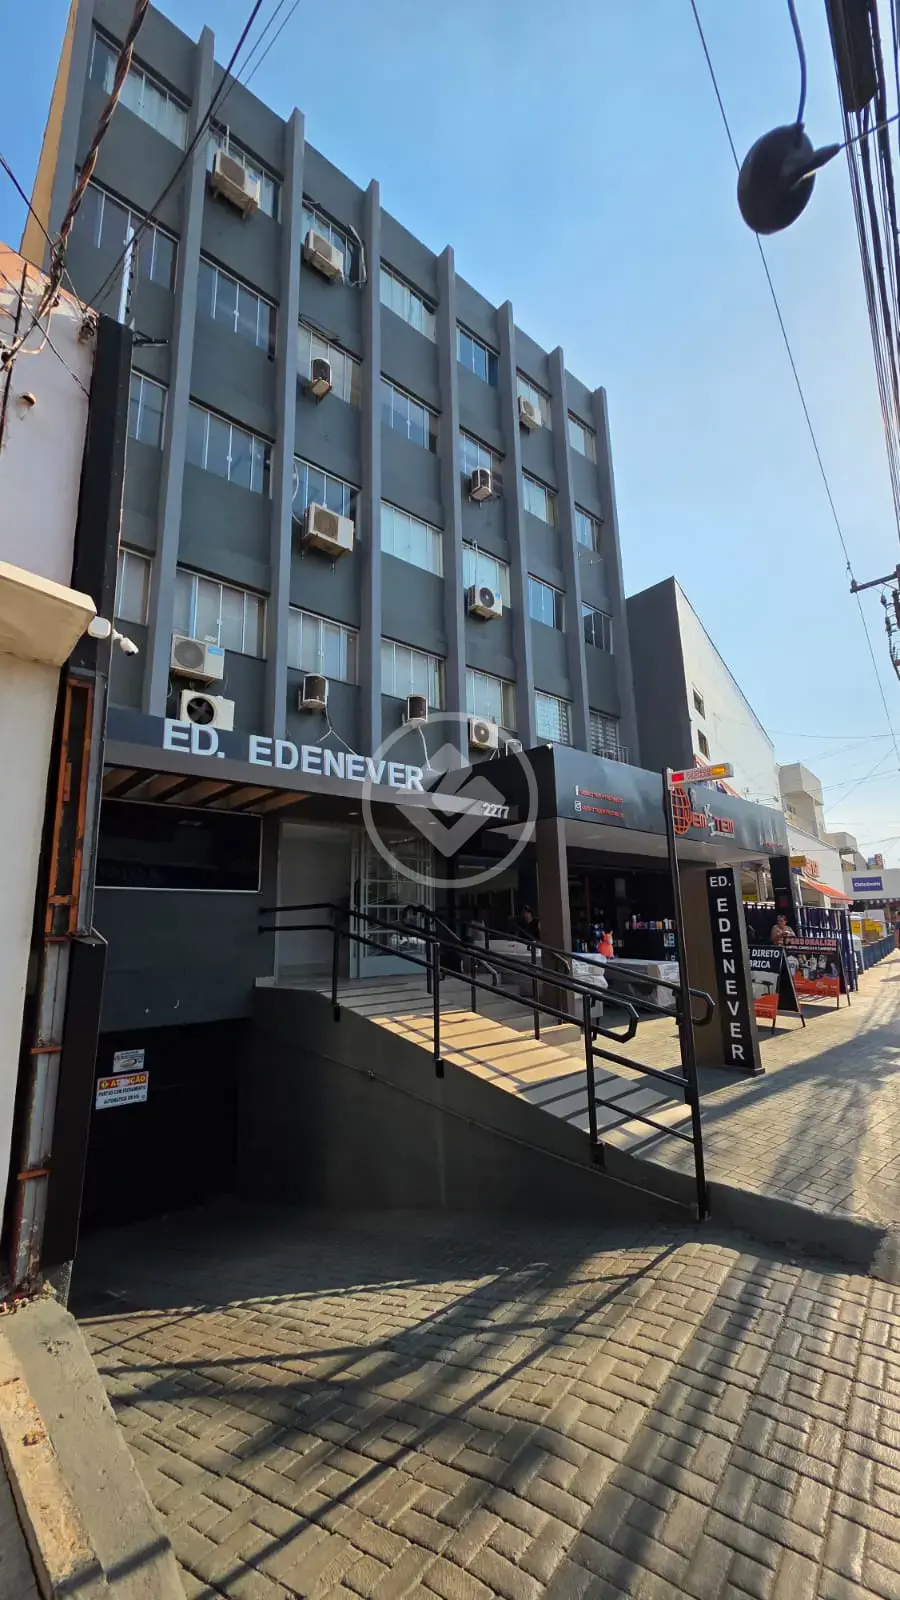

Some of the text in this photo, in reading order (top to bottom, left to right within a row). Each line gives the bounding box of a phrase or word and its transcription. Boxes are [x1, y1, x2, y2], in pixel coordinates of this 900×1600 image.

[162, 719, 424, 792] ED. EDENEVER
[483, 802, 509, 819] 2277
[709, 875, 732, 888] ED.
[751, 949, 780, 958] DIRETO
[717, 897, 745, 1061] EDENEVER
